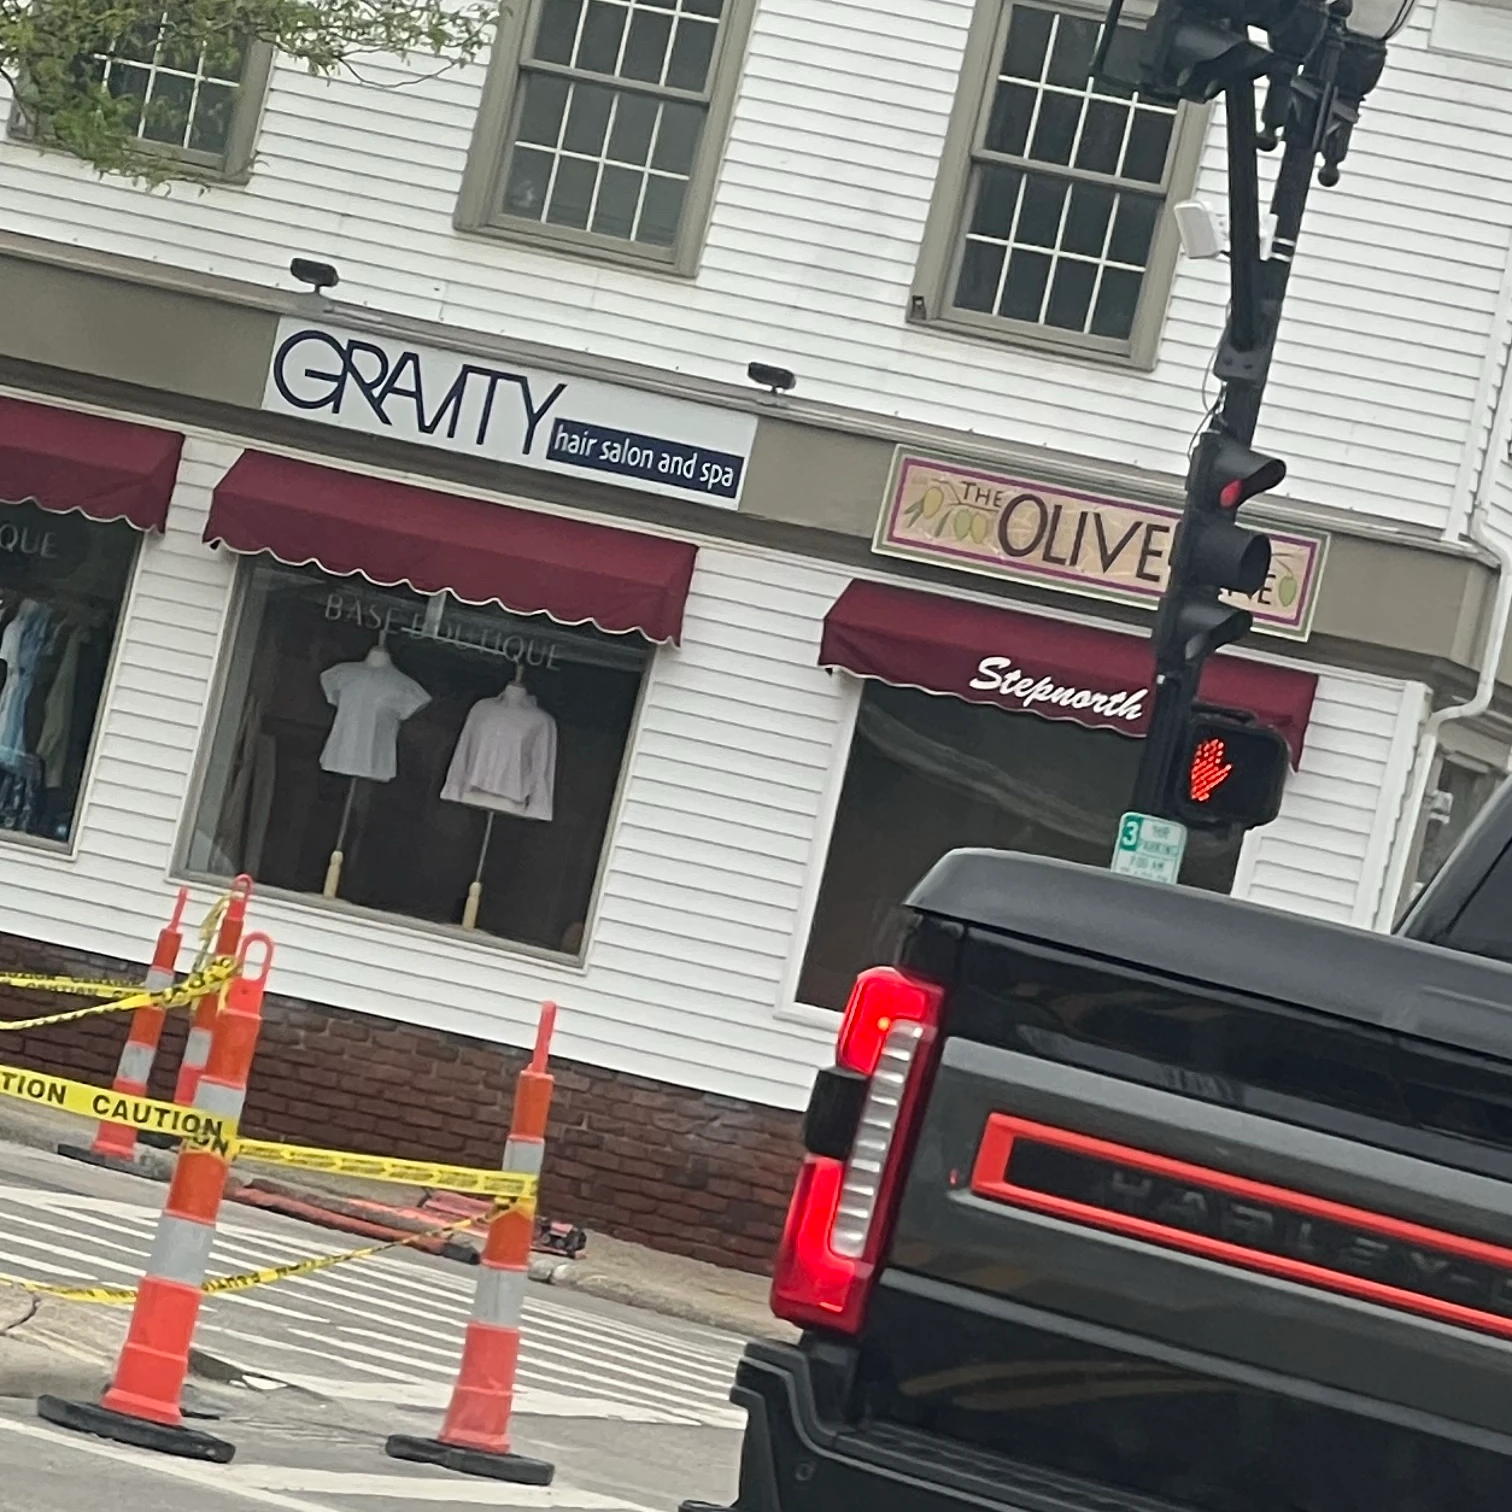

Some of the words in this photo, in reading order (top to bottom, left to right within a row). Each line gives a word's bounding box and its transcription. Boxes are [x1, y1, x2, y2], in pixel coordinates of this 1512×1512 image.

[274, 330, 567, 456] GRAVITY
[554, 425, 597, 458] hair
[600, 440, 653, 469] salon
[658, 452, 697, 481] and
[700, 460, 734, 490] spa
[961, 481, 1004, 508] THE
[998, 493, 1171, 583] OLIVE
[325, 593, 399, 634] BASE
[969, 656, 1148, 721] Stepnorth
[1123, 820, 1138, 846] 3
[93, 1095, 223, 1136] CAUTION
